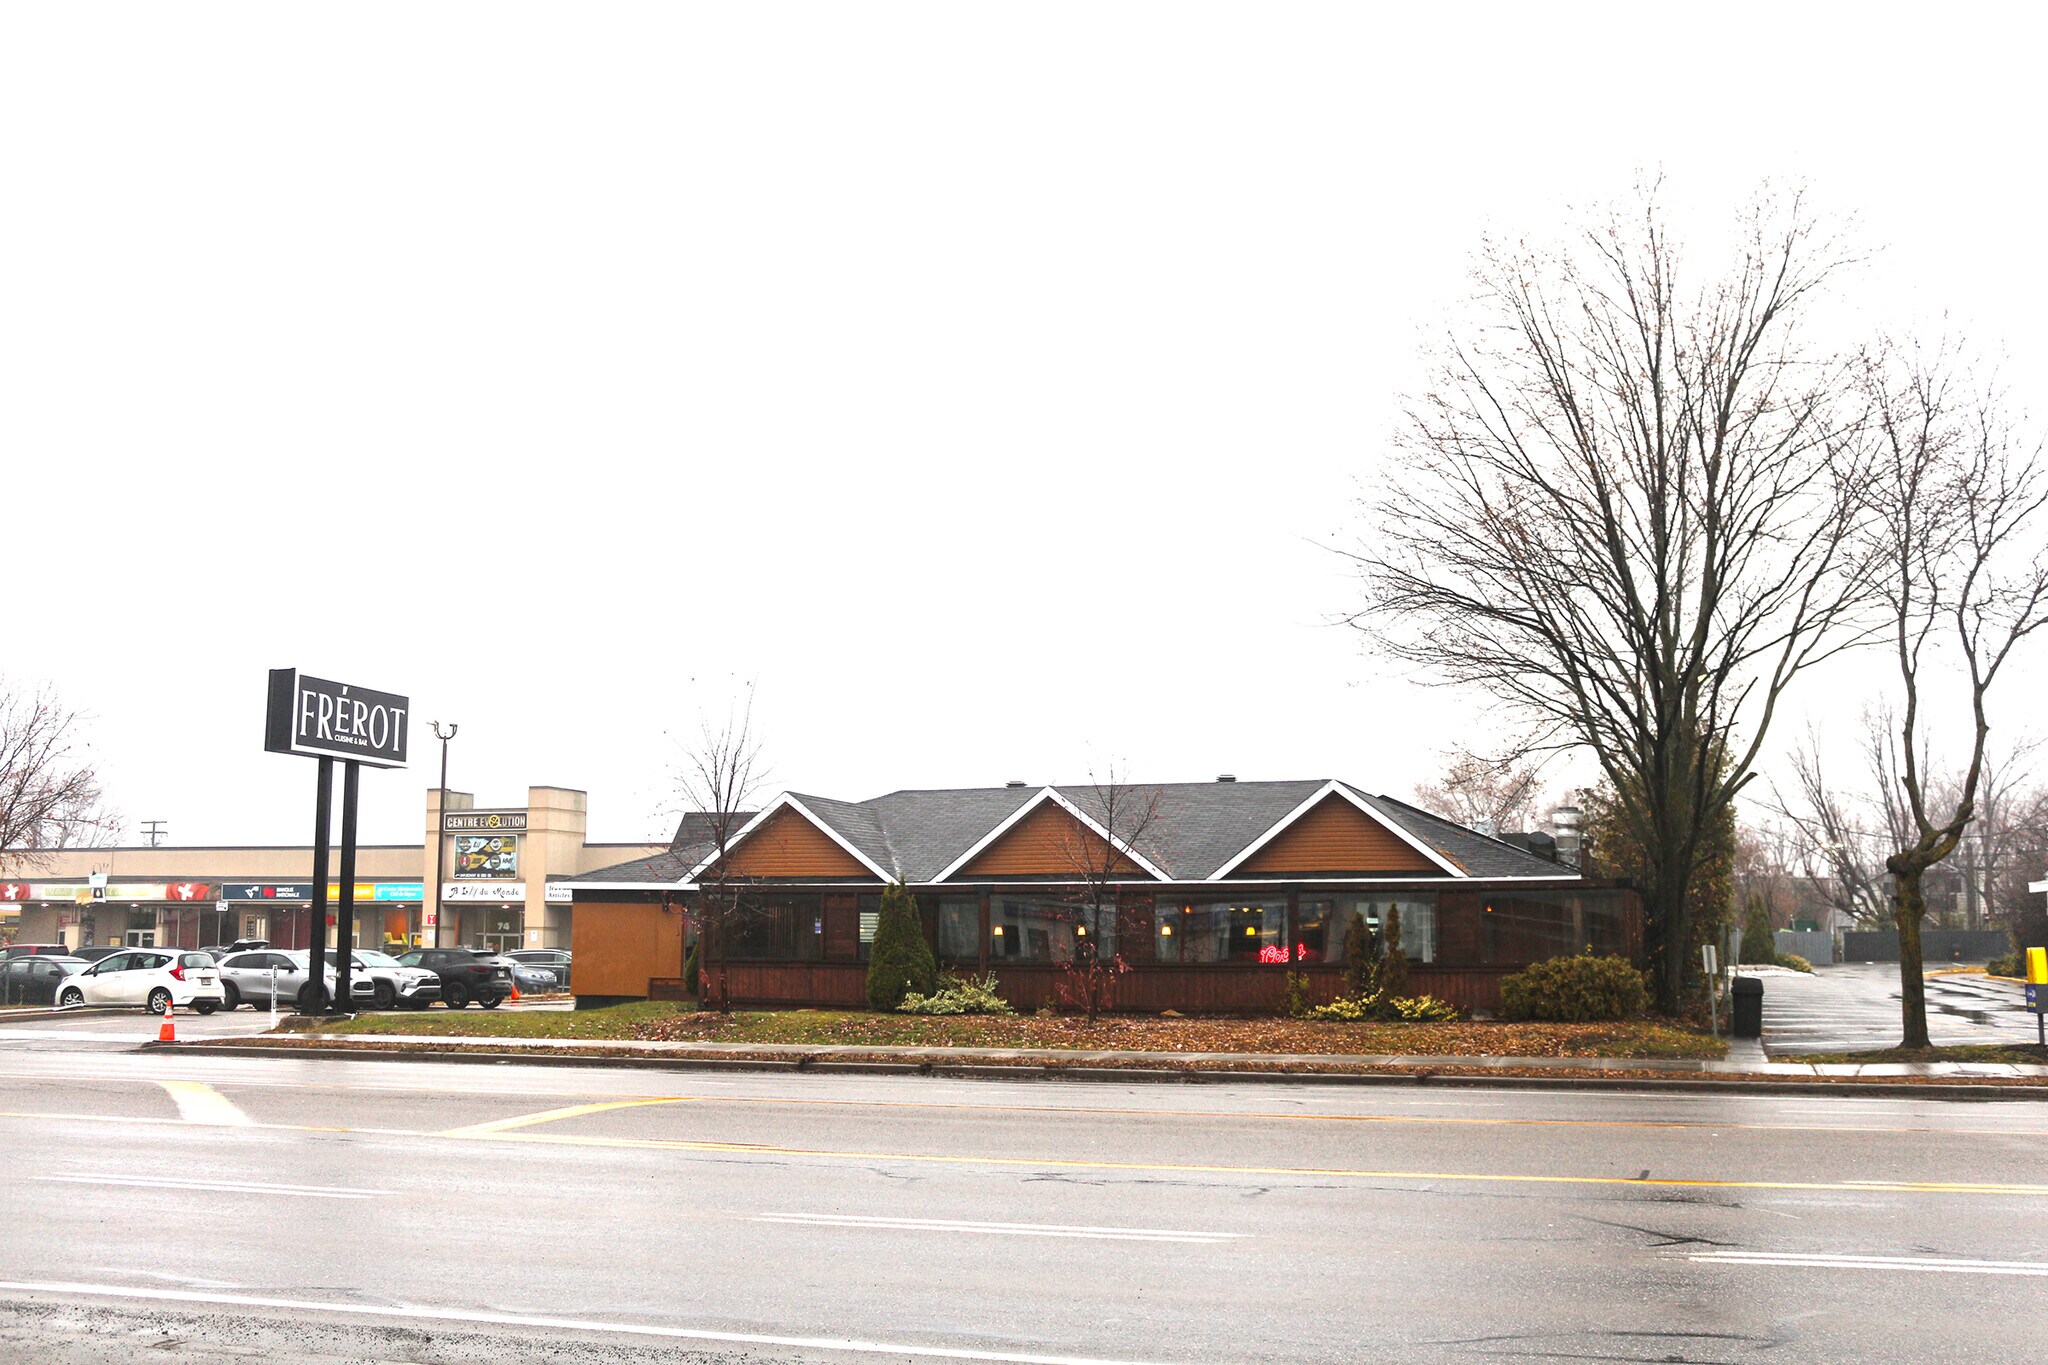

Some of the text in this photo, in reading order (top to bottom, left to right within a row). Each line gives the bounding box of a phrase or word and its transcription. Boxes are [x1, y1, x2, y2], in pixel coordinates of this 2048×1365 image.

[300, 686, 406, 752] FRÉROT
[334, 734, 354, 744] CUISINE
[358, 738, 368, 747] BAR
[447, 817, 478, 828] CENTRE
[479, 888, 489, 896] du
[492, 887, 519, 898] Monde
[497, 922, 510, 931] 74
